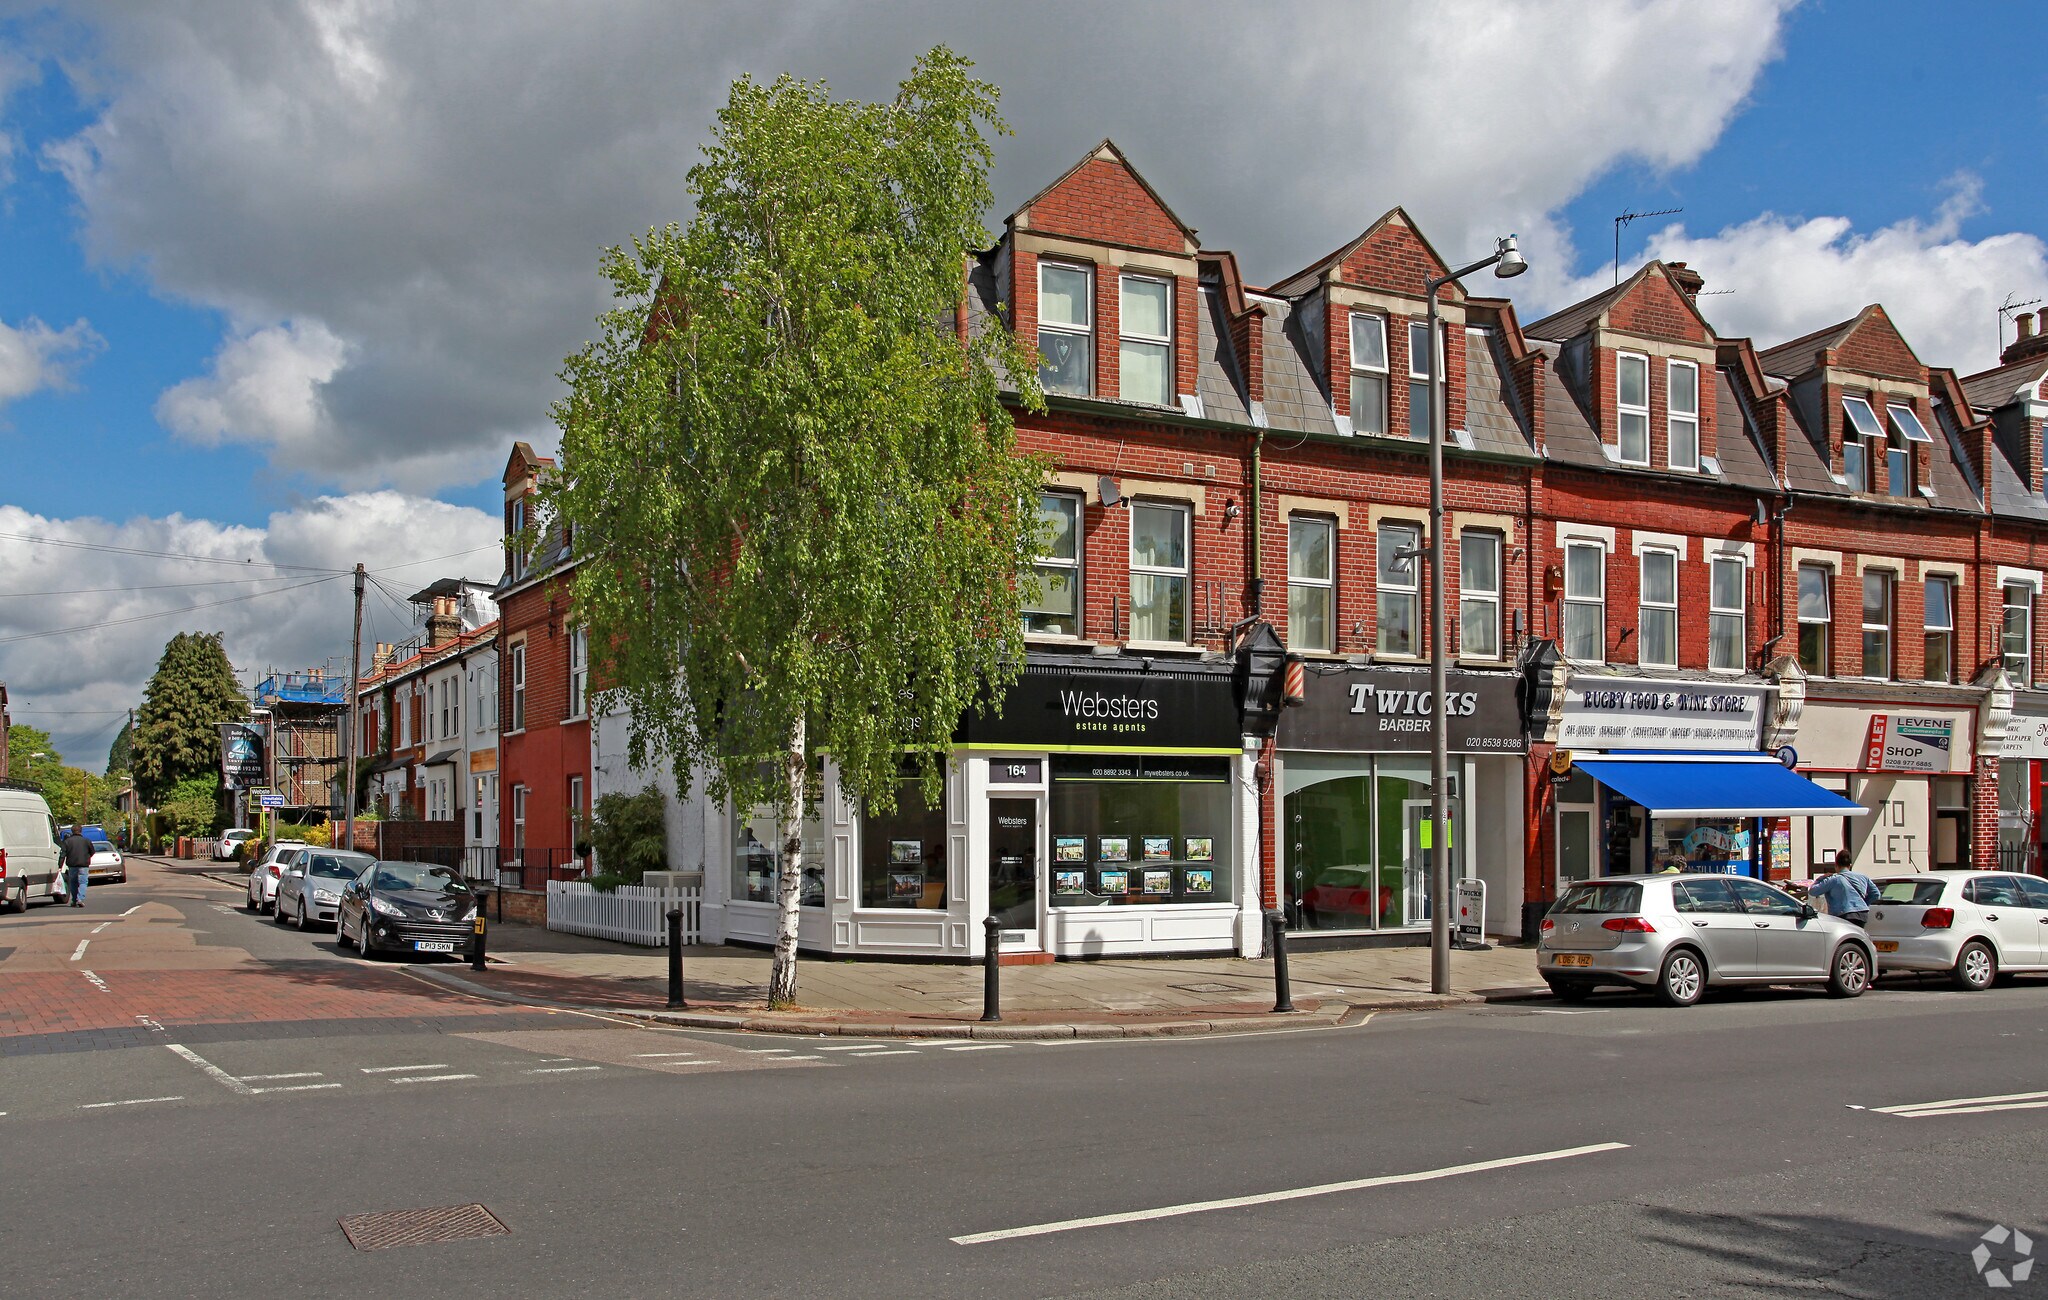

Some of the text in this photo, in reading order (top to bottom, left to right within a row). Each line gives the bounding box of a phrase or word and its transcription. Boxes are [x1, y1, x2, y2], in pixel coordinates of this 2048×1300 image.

[1060, 690, 1158, 719] Websters
[1350, 683, 1477, 716] TWICKS
[1584, 690, 1625, 709] RUGBY
[1631, 692, 1658, 710] FOOD
[1662, 693, 1674, 710] &
[1712, 695, 1745, 712] STORE
[1076, 722, 1146, 732] estate agents
[1897, 718, 1952, 728] LEVENE
[1466, 737, 1522, 748] 020 8538 9386
[1869, 716, 1885, 766] TO LET
[1886, 746, 1923, 757] SHOP
[1007, 765, 1027, 776] 164
[1092, 768, 1103, 776] 020
[1103, 768, 1117, 776] 8892
[1144, 769, 1190, 777] mywebsters.co.uk
[1879, 800, 1904, 827] TO
[997, 816, 1027, 825] Websters
[1873, 834, 1915, 864] LET
[1716, 865, 1737, 875] LATE
